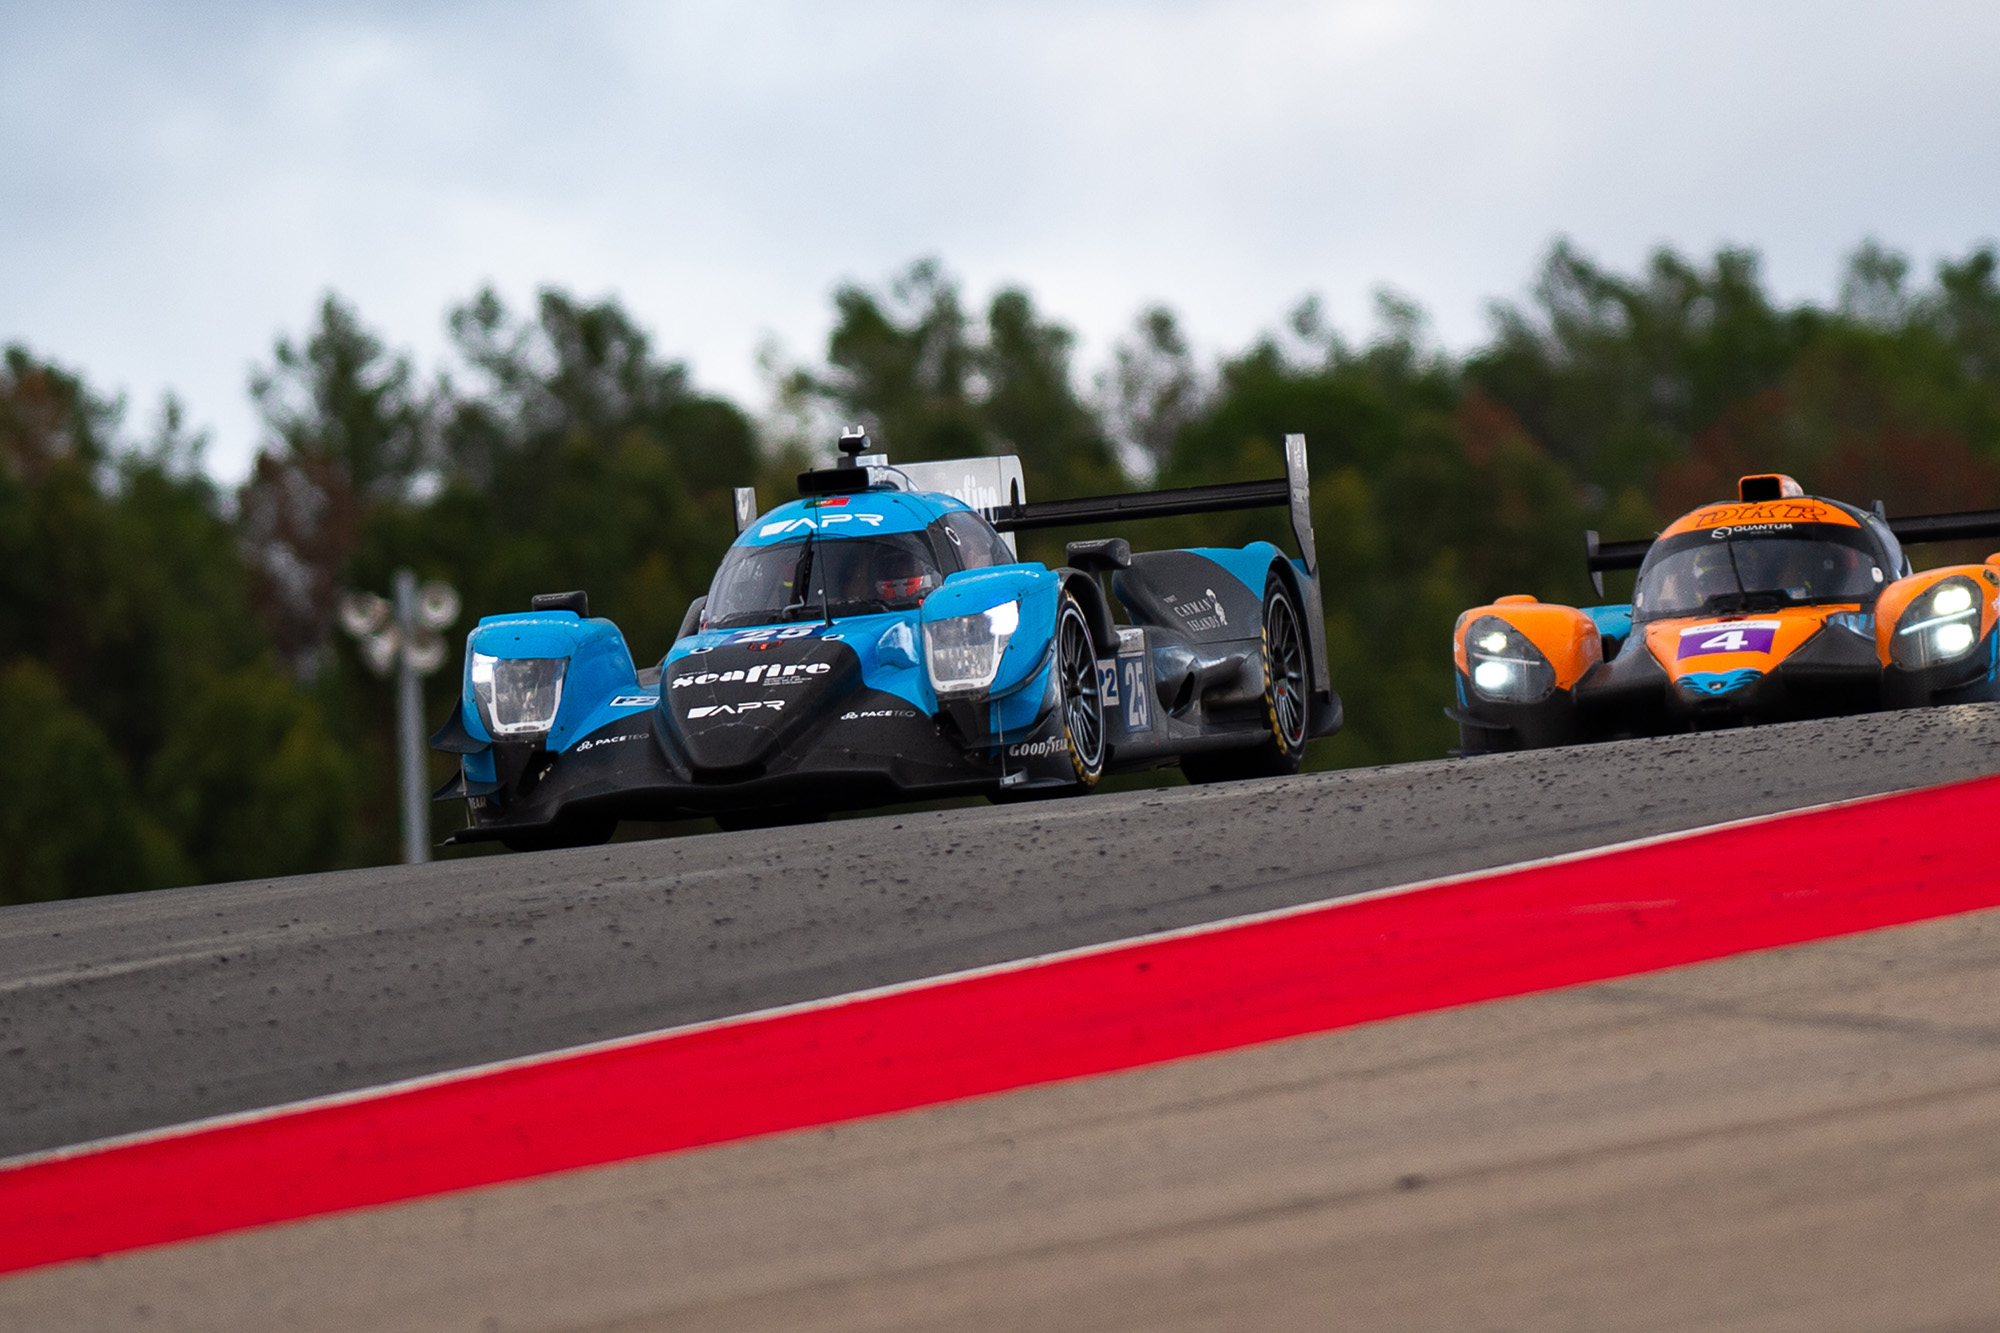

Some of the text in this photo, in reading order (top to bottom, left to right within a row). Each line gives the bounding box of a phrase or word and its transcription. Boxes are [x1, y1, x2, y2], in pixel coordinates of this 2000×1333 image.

[780, 513, 884, 533] APR
[1733, 523, 1793, 532] QUANTUM
[1173, 598, 1212, 617] CAYMAN
[733, 628, 814, 644] 25
[1700, 630, 1748, 650] 4
[672, 662, 831, 689] seafire
[1125, 661, 1147, 727] 25
[709, 700, 786, 716] APR
